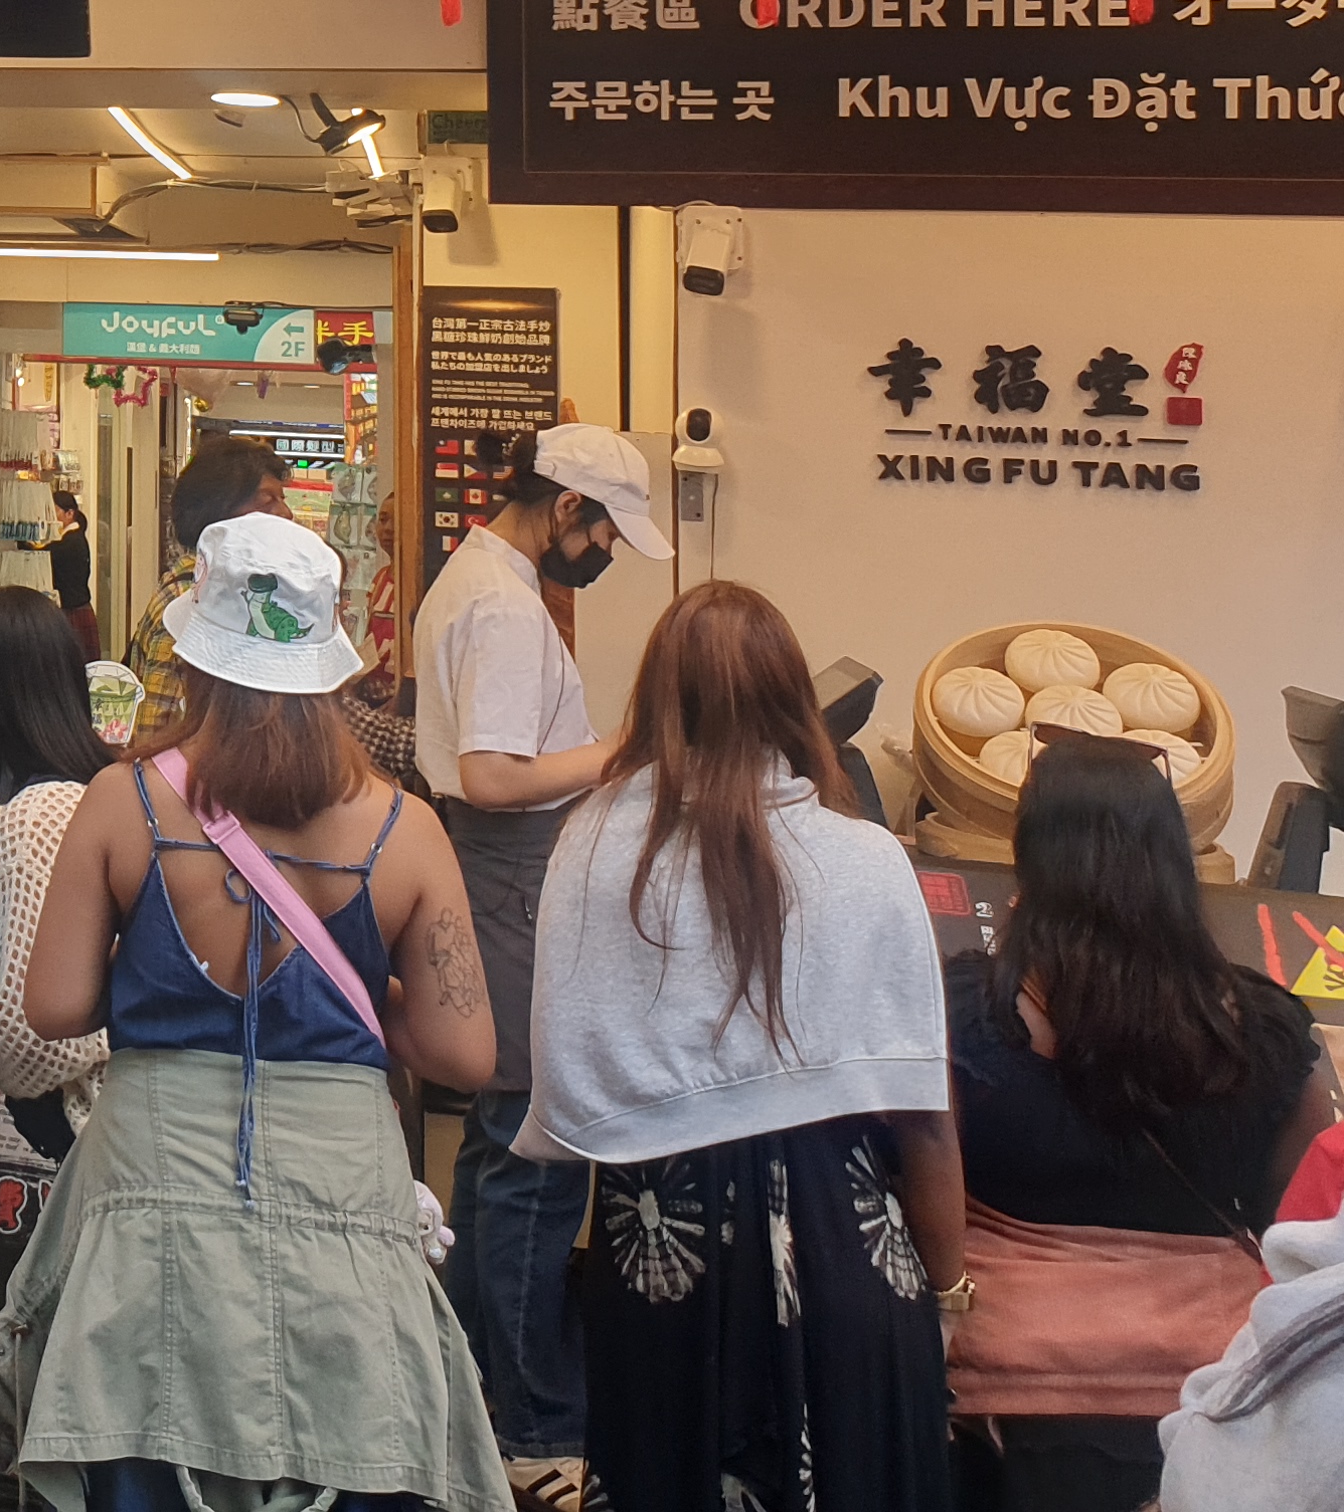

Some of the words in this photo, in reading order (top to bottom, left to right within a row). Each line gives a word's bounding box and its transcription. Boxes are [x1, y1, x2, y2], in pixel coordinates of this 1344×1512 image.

[549, 79, 719, 122] 주문하는
[732, 79, 776, 122] 곳
[837, 76, 949, 120] Khu
[964, 75, 1072, 131] Vực
[1090, 72, 1197, 133] Đặt
[1212, 67, 1344, 121] Thứ
[280, 340, 306, 358] 2F
[867, 337, 1150, 418] 幸福堂
[938, 423, 1048, 444] TAIWAN
[1061, 428, 1134, 448] NO.1
[876, 453, 992, 484] XING
[1002, 457, 1058, 486] FU
[1072, 460, 1201, 491] TANG
